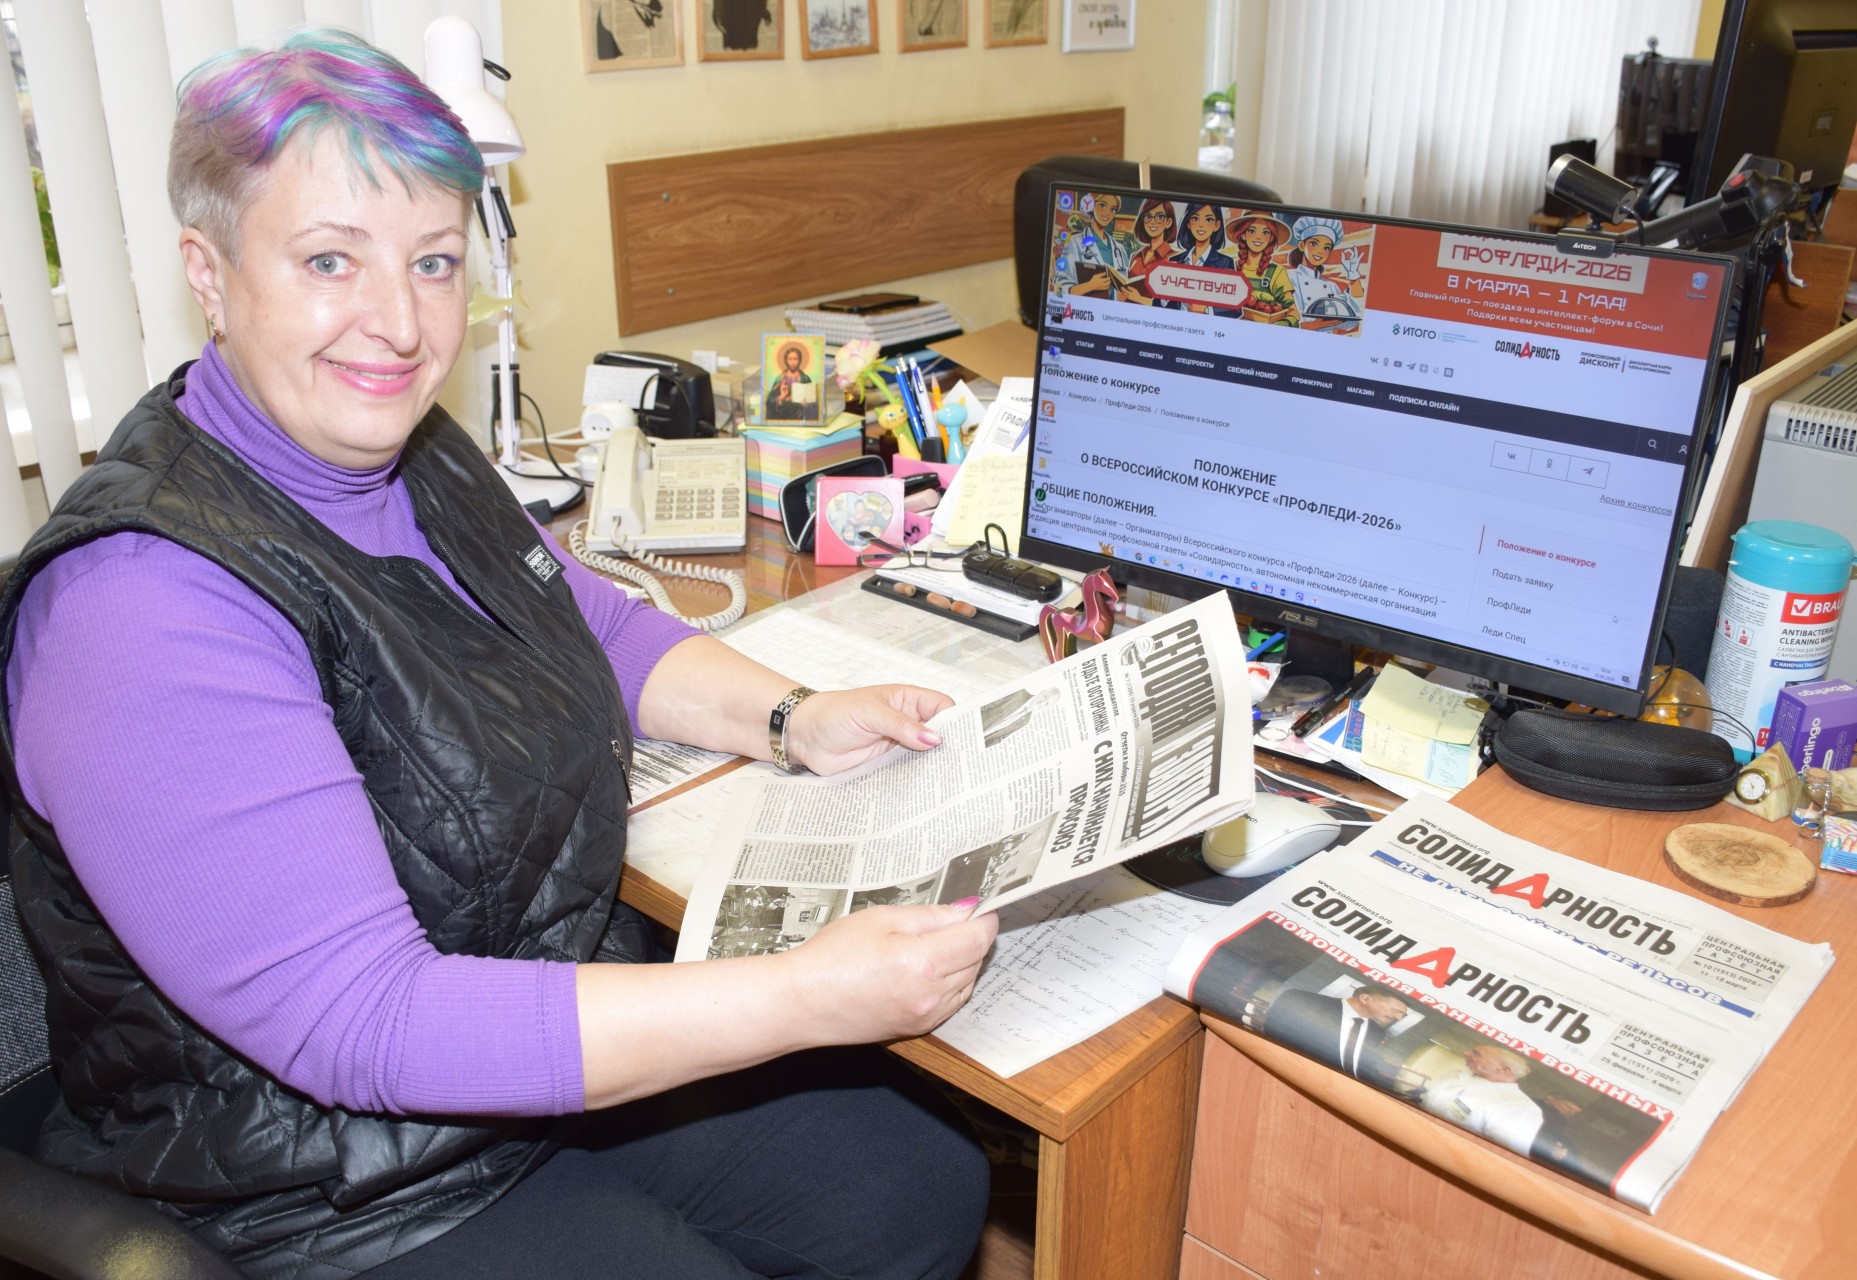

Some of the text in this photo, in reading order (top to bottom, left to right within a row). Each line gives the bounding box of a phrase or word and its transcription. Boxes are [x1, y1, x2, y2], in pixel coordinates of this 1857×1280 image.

[1452, 244, 1632, 282] ПРОФЛЕДИ-2026
[1160, 273, 1237, 295] УЧАСТВУЮ!
[1447, 275, 1627, 312] 8 МАРТА 1 МАЯ!
[1102, 314, 1205, 336] Центральная профсоюзная газета
[1410, 289, 1448, 301] Главный
[1448, 295, 1471, 305] приз
[1483, 300, 1522, 313] поездка
[1524, 306, 1535, 314] на
[1537, 308, 1625, 328] интеллект-форум
[1634, 320, 1664, 333] Сочи!
[1467, 308, 1596, 335] Подарки всем участницам!
[1075, 340, 1095, 349] СТАТЬИ
[1214, 331, 1226, 339] 16+
[1402, 326, 1437, 340] ИТОГО
[1106, 345, 1127, 354] МНЕНИЯ
[1139, 350, 1163, 360] СЮЖЕТЫ
[1175, 356, 1215, 369] СПЕЦПРОЕКТЫ
[1495, 339, 1560, 361] СОЛИДАРНОСТЬ
[1579, 357, 1620, 370] ДИСКОНТ
[1101, 376, 1108, 385] о
[1110, 377, 1161, 395] конкурсе
[1227, 365, 1278, 380] СВЕЖИЙ НОМЕР
[1291, 376, 1333, 390] ПРОФЖУРНАЛ
[1346, 386, 1375, 397] МАГАЗИН
[1389, 393, 1460, 412] ПОДПИСКА ОНЛАЙН
[1068, 391, 1096, 404] Конкурсы
[1105, 398, 1152, 414] ПрофЛеди-2026
[1160, 409, 1196, 422] Положение
[1201, 416, 1231, 429] конкурсе
[1194, 459, 1277, 487] ПОЛОЖЕНИЕ
[1042, 482, 1157, 518] ОБЩИЕ ПОЛОЖЕНИЯ.
[1081, 453, 1402, 532] О ВСЕРОССИЙСКОМ КОНКУРСЕ «ПРОФЛЕДИ-2026»
[1600, 494, 1673, 517] Архив конкурсов
[1093, 514, 1118, 528] (далее
[1125, 522, 1182, 544] Организаторы)
[1183, 536, 1247, 558] Всероссийского
[1247, 552, 1285, 568] конкурса
[1286, 561, 1358, 585] «ПрофЛеди-2026
[1359, 577, 1388, 594] (далее
[1398, 587, 1438, 607] Конкурс)
[1497, 539, 1597, 569] Положение о конкурсе
[1061, 520, 1107, 538] центральной
[1108, 531, 1160, 551] профсоюзной
[1161, 544, 1188, 558] газеты
[1189, 550, 1254, 574] «Солидарность»,
[1256, 568, 1305, 586] автономная
[1306, 580, 1378, 604] некоммерческая
[1380, 596, 1437, 619] организация
[1492, 568, 1554, 591] Подать заявку
[1486, 597, 1532, 615] ПрофЛеди
[1481, 625, 1527, 645] Леди Спец
[1779, 637, 1820, 646] CLEANING
[1139, 618, 1216, 744] СЕГОДНЯ
[1082, 658, 1110, 735] БУДЬТЕ ОСТОРОЖНЫ!
[1138, 734, 1215, 838] ЗАВТРА
[1050, 782, 1089, 854] ПРОФСОЮЗ
[1071, 740, 1114, 869] С НИХ НАЧИНАЕТСЯ
[1419, 817, 1490, 855] www.solidarnost.org
[1317, 878, 1393, 924] www.solidarnost.org
[1397, 824, 1676, 956] СОЛИДАРНОСТЬ
[1398, 861, 1428, 880] НЕ
[1605, 951, 1724, 1005] РЕЛЬСОВ
[1291, 886, 1591, 1045] СОЛИДАРНОСТЬ
[1702, 941, 1780, 976] ПРОФСОЮЗНАЯ
[1706, 935, 1785, 970] ЦЕНТРАЛЬНАЯ
[1725, 978, 1747, 991] марта
[1738, 975, 1756, 986] 2026
[1268, 910, 1361, 968] ПОМОЩЬ
[1364, 968, 1417, 996] ДЛЯ
[1419, 994, 1538, 1057] РАНЕНЫХ
[1540, 1054, 1672, 1122] ВОЕННЫХ
[1619, 1030, 1705, 1070] ПРОФСОЮЗНАЯ
[1624, 1024, 1710, 1063] ЦЕНТРАЛЬНАЯ
[1611, 1061, 1645, 1081] февраля
[1657, 1082, 1682, 1096] марта
[1654, 1069, 1675, 1083] 2026
